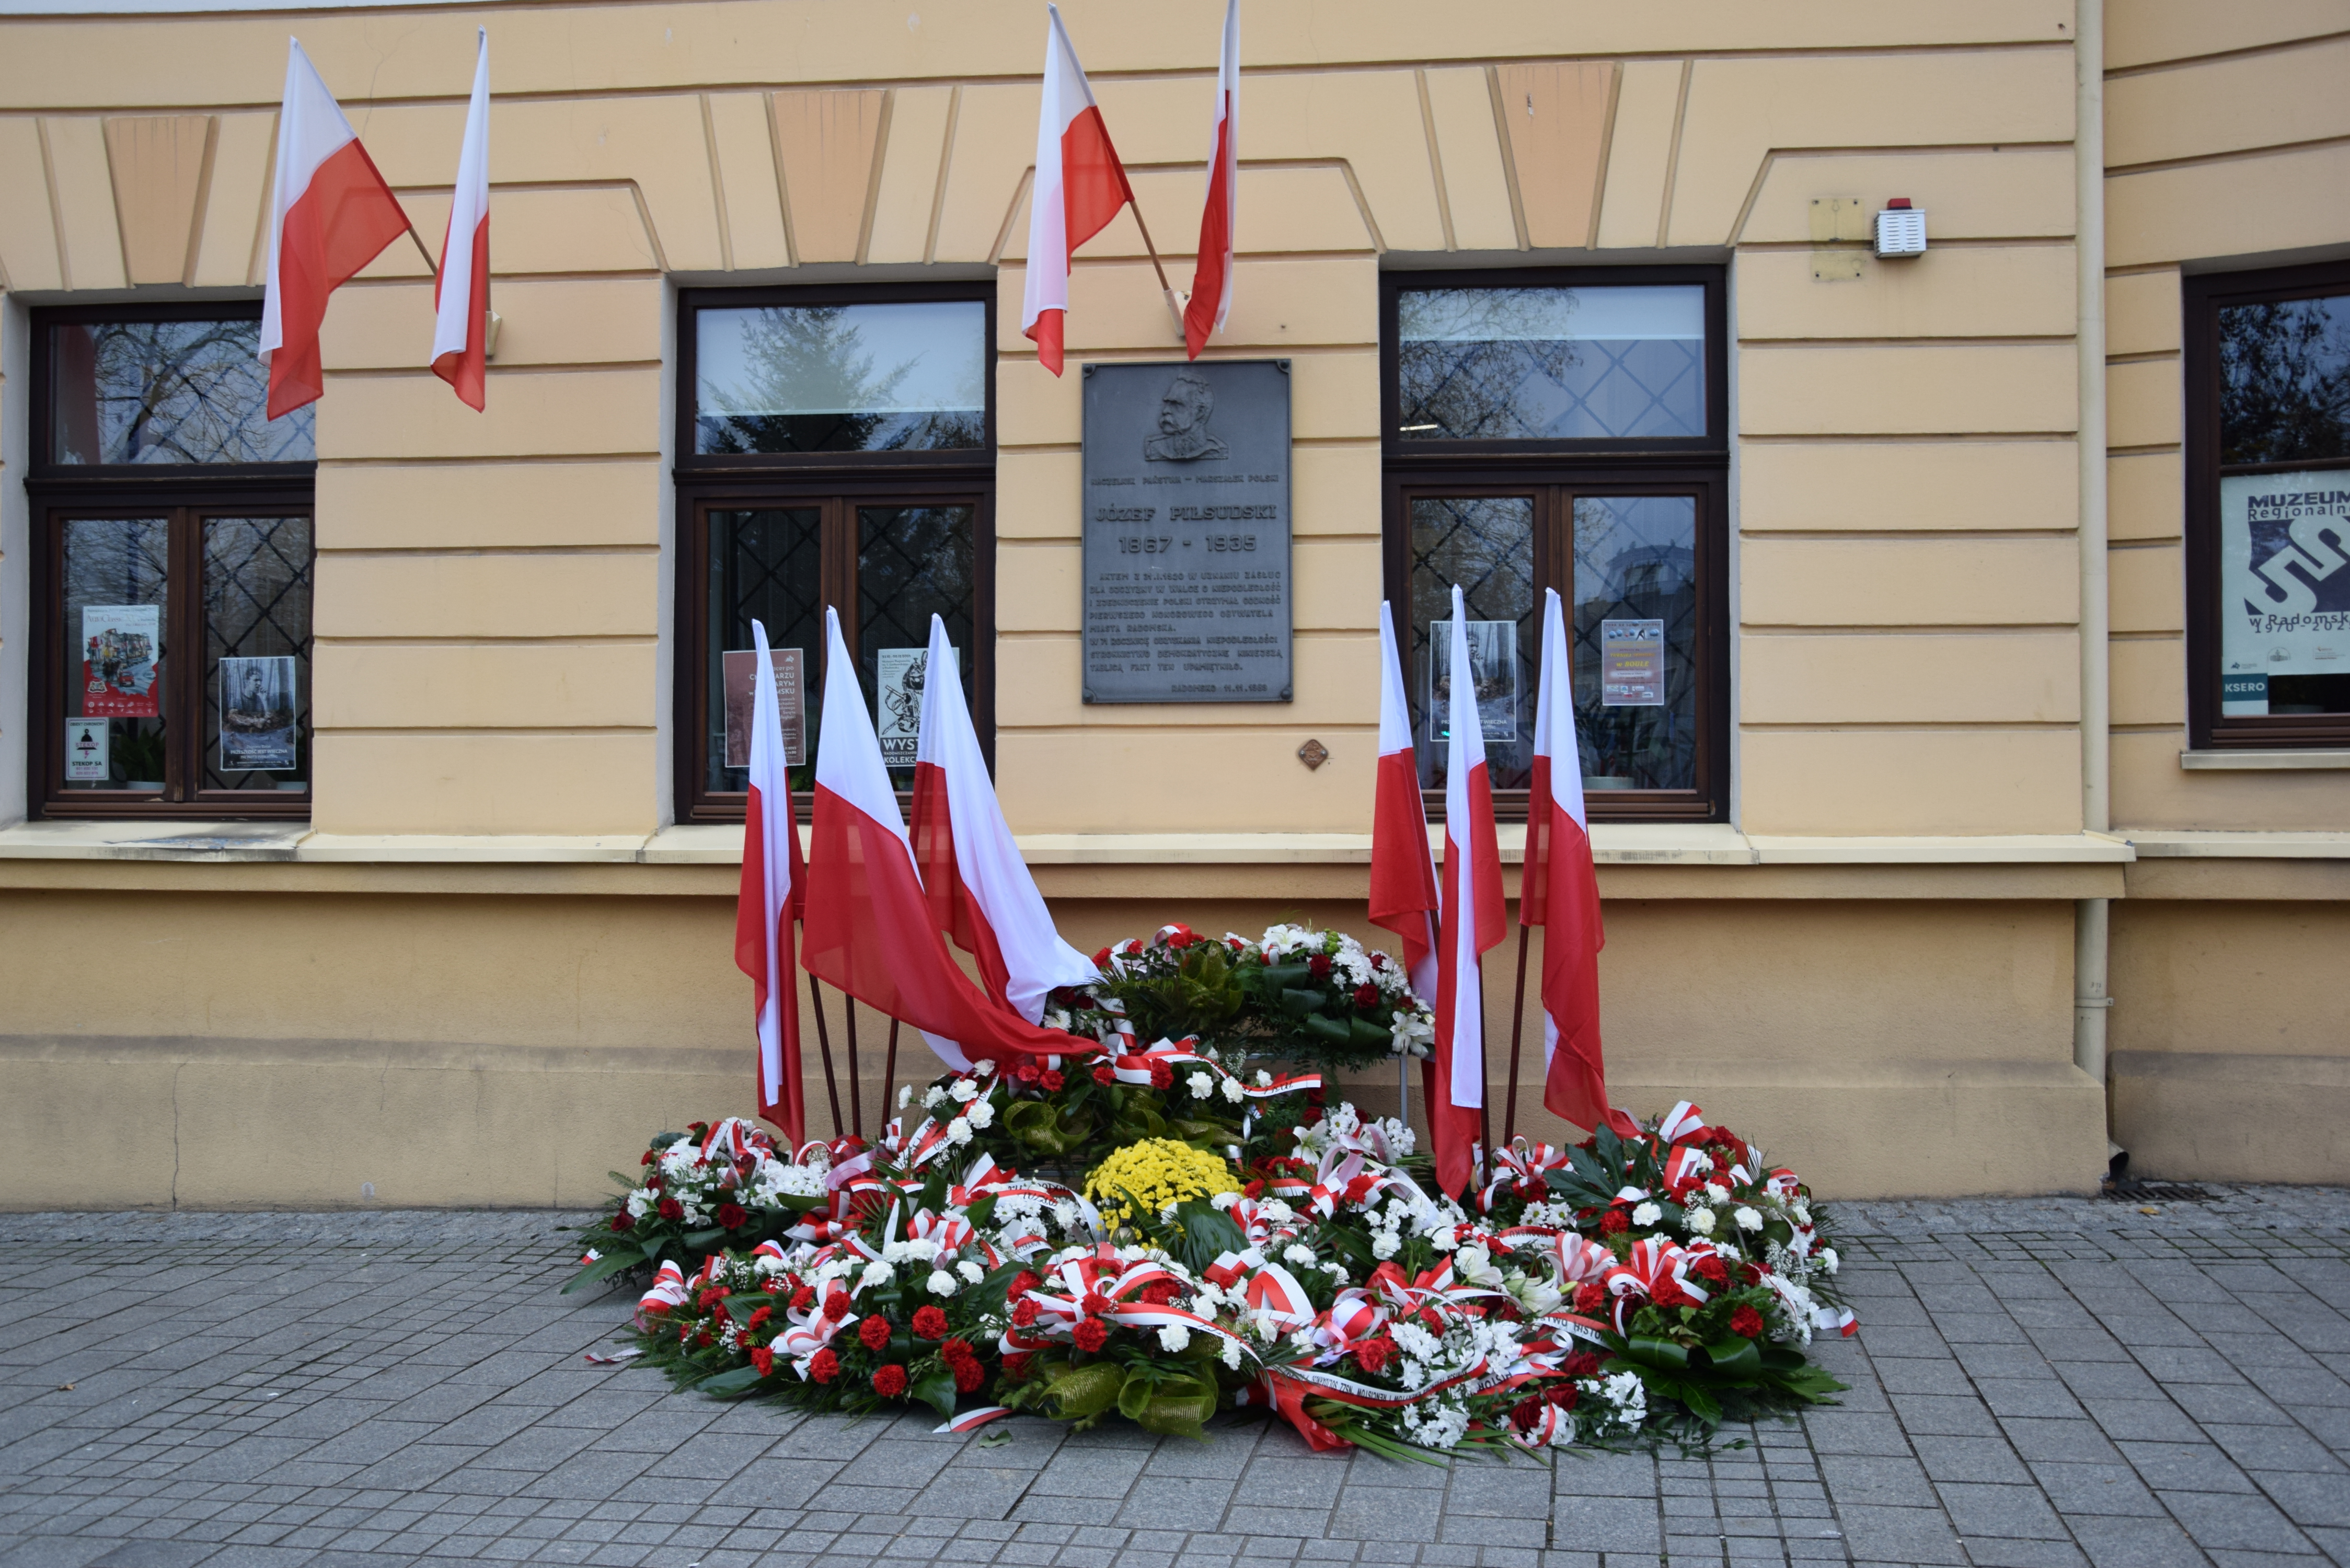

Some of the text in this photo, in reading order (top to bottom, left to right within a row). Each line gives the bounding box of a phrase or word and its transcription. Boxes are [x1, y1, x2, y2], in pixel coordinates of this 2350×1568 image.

[1091, 477, 1135, 486] NACZELNIK
[1196, 475, 1244, 483] MARSZAŁEK
[2248, 491, 2350, 509] MUZEUM
[1096, 503, 1277, 521] JÓZEF PIŁSUDSKI
[2248, 503, 2350, 521] Regionaln
[1119, 536, 1173, 553] 1867
[1205, 535, 1257, 551] 1935
[1089, 585, 1105, 594] DLA
[1156, 585, 1165, 593] W
[1169, 585, 1199, 593] WALCE
[1202, 585, 1208, 593] O
[1089, 610, 1145, 620] PIERWSZEGO
[1151, 610, 1214, 619] HONOROWEGO
[1089, 625, 1121, 633] MIASTA
[1090, 638, 1098, 646] W
[1090, 650, 1150, 659] STRONNICTWO
[1157, 650, 1229, 658] DEMOKRATYCZNE
[1157, 663, 1174, 672] TEN
[1171, 684, 1216, 693] RADOMSKO
[2225, 682, 2265, 693] KSERO
[884, 756, 917, 765] KOLEKC
